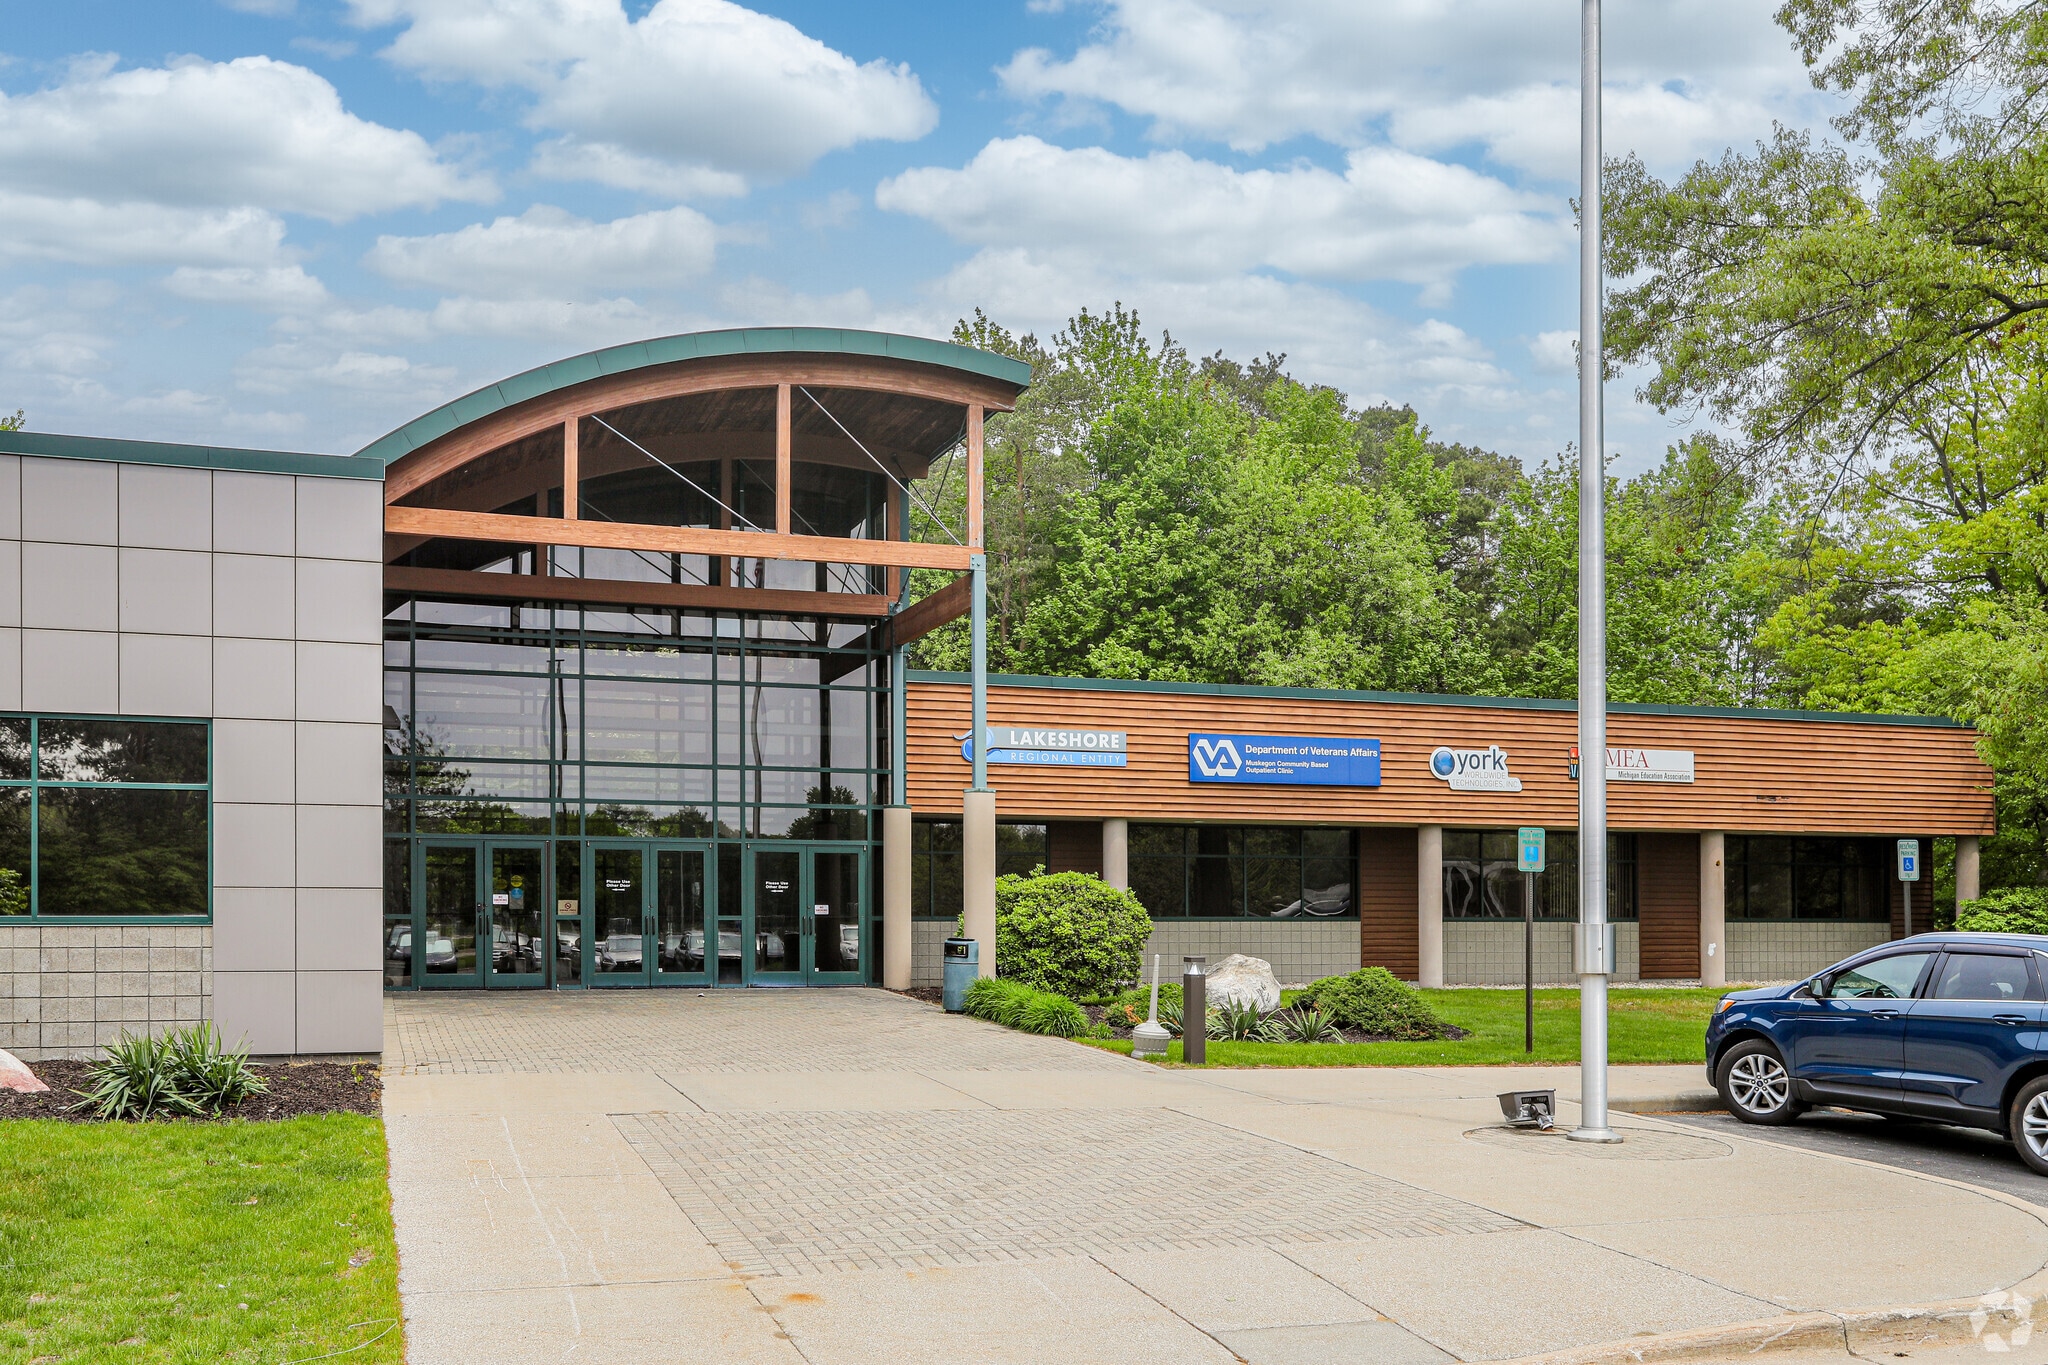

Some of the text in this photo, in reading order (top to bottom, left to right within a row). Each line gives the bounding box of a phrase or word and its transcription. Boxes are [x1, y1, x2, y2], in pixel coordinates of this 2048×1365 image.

[1010, 731, 1120, 748] LAKESHORE
[1011, 752, 1120, 763] REGIONAL ENTITY
[1192, 738, 1242, 776] VA
[1245, 745, 1378, 758] Department of Veterans Affairs
[1277, 760, 1309, 769] Community
[1457, 748, 1504, 774] york
[1606, 749, 1649, 768] MEA
[1463, 771, 1506, 779] WORLDWIDE
[1618, 771, 1690, 781] Michigan Education Association
